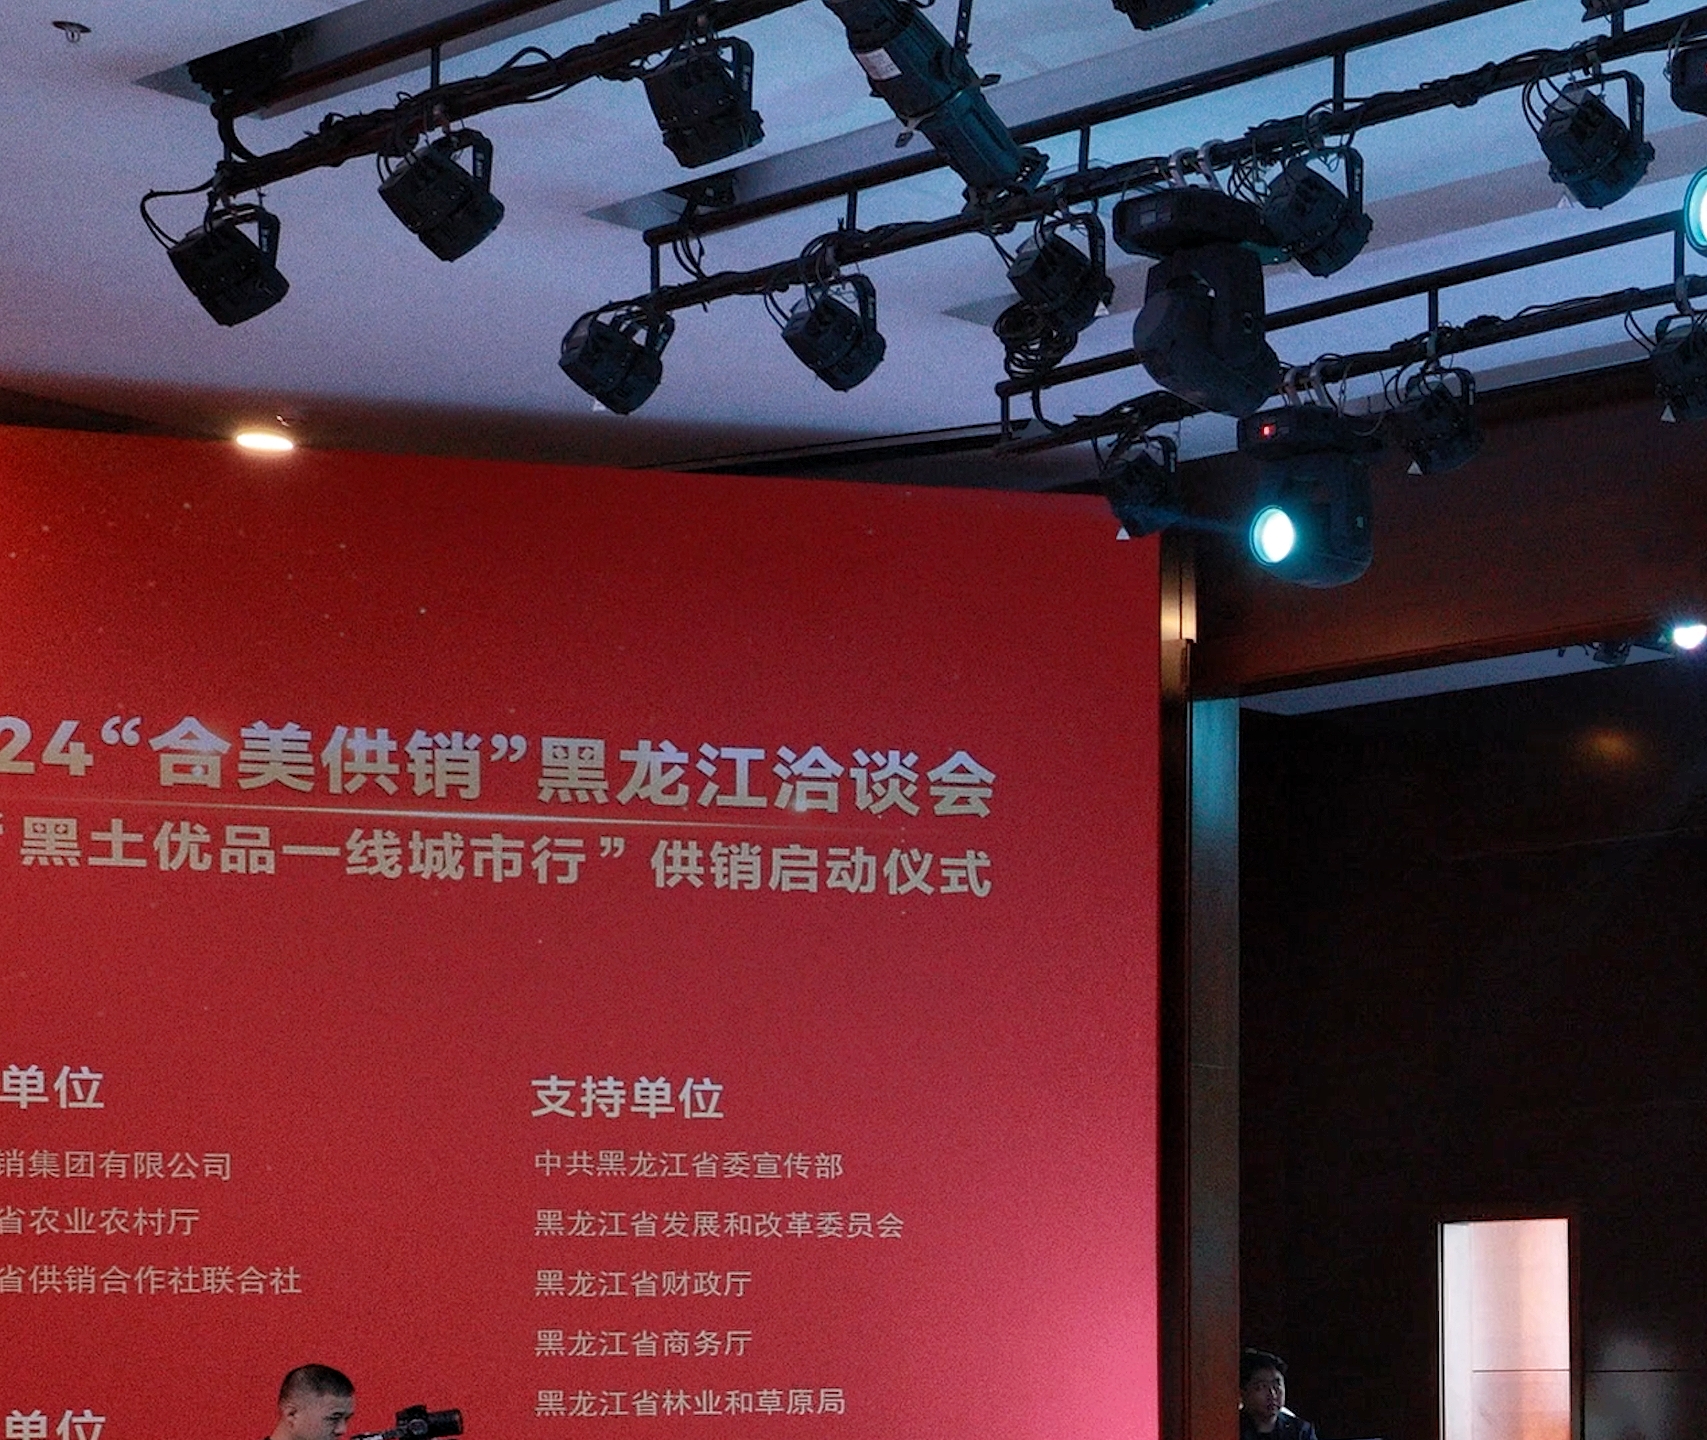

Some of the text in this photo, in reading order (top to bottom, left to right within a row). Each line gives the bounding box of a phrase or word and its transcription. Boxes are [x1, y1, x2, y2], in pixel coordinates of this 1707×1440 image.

[0, 813, 992, 898] 黑土优品一线城市行”供销启动仪式
[2, 1064, 105, 1110] 单位
[530, 1074, 725, 1120] 支持单位
[0, 1148, 232, 1181] 销集团有限公司
[534, 1149, 844, 1180] 中共黑龙江省委宣传部
[0, 1205, 200, 1237] 省农业农村厅
[533, 1208, 905, 1240] 黑龙江省发展和改革委员会
[0, 1264, 302, 1296] 省供销合作社联合社
[534, 1269, 752, 1298] 黑龙江省财政厅
[534, 1329, 753, 1358] 黑龙江省商务厅
[534, 1387, 846, 1418] 黑龙江省林业和草原局
